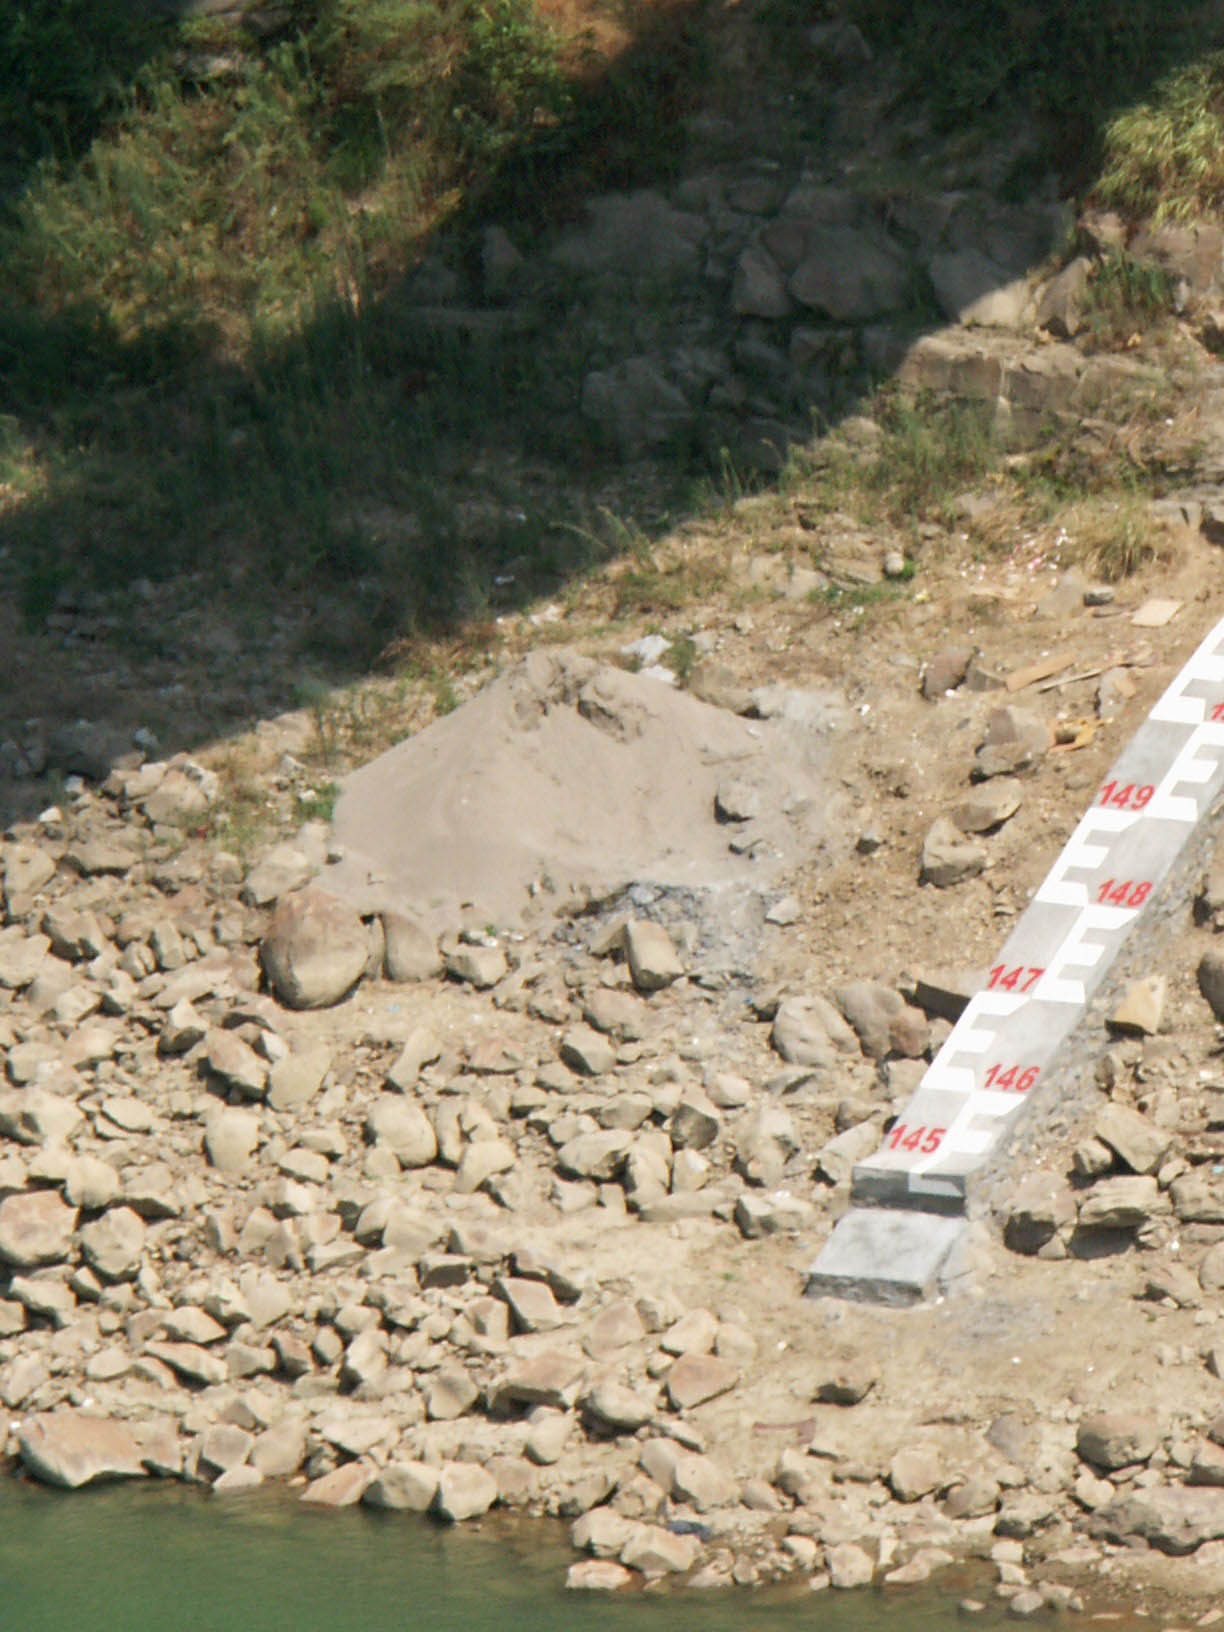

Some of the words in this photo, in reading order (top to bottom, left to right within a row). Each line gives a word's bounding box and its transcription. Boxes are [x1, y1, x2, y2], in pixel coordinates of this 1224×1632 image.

[1098, 778, 1156, 812] 149
[1095, 878, 1154, 909] 148
[986, 962, 1047, 994] 147
[983, 1063, 1042, 1094] 146
[887, 1122, 948, 1155] 145
